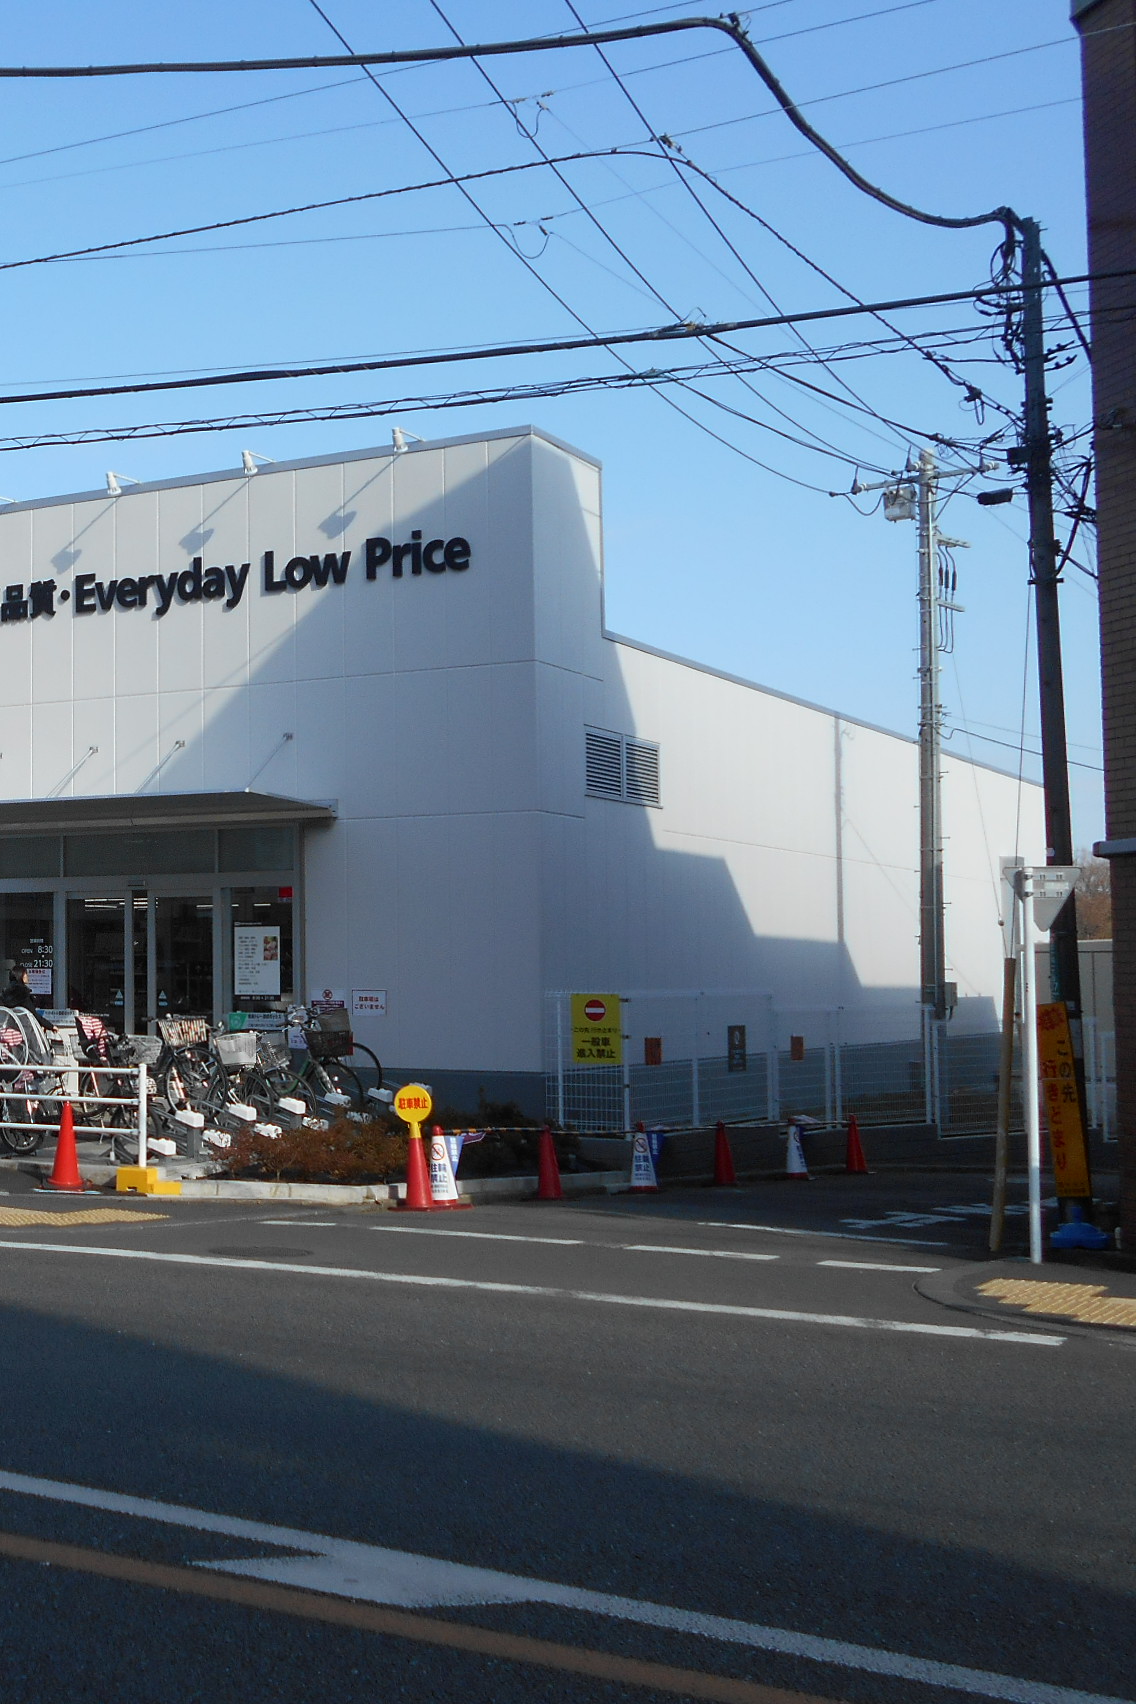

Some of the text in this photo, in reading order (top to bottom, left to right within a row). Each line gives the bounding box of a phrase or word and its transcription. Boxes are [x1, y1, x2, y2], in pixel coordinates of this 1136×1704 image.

[75, 557, 251, 616] Everyday
[264, 551, 352, 592] Low
[365, 530, 471, 580] Price
[34, 959, 53, 968] 21:30
[582, 1036, 611, 1046] 一般車
[576, 1048, 616, 1059] 進入禁止
[398, 1097, 428, 1110] 駐車禁止
